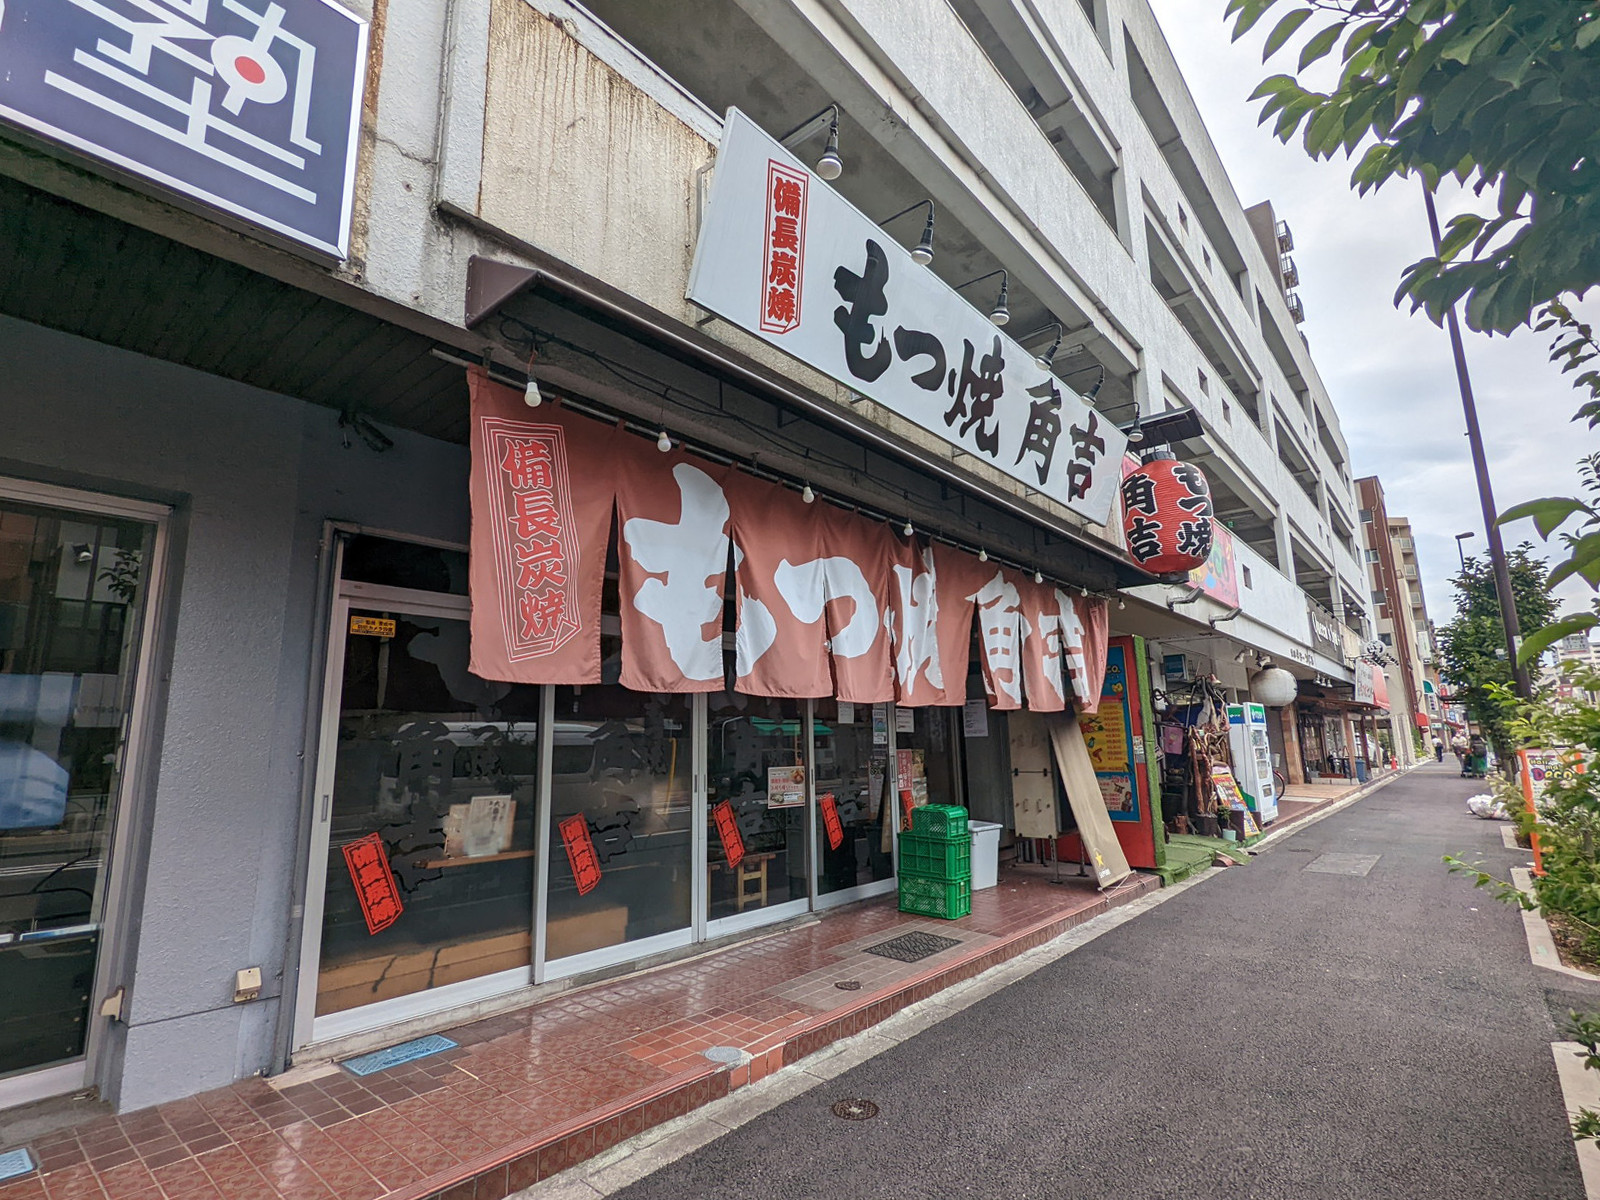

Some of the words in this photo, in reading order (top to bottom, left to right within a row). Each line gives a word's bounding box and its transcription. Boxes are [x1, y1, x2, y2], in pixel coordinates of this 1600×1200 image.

[767, 177, 801, 322] 備長炭焼
[500, 438, 567, 640] 備長炭焼
[1121, 472, 1164, 565] 角吉
[1171, 461, 1214, 559] もつ焼
